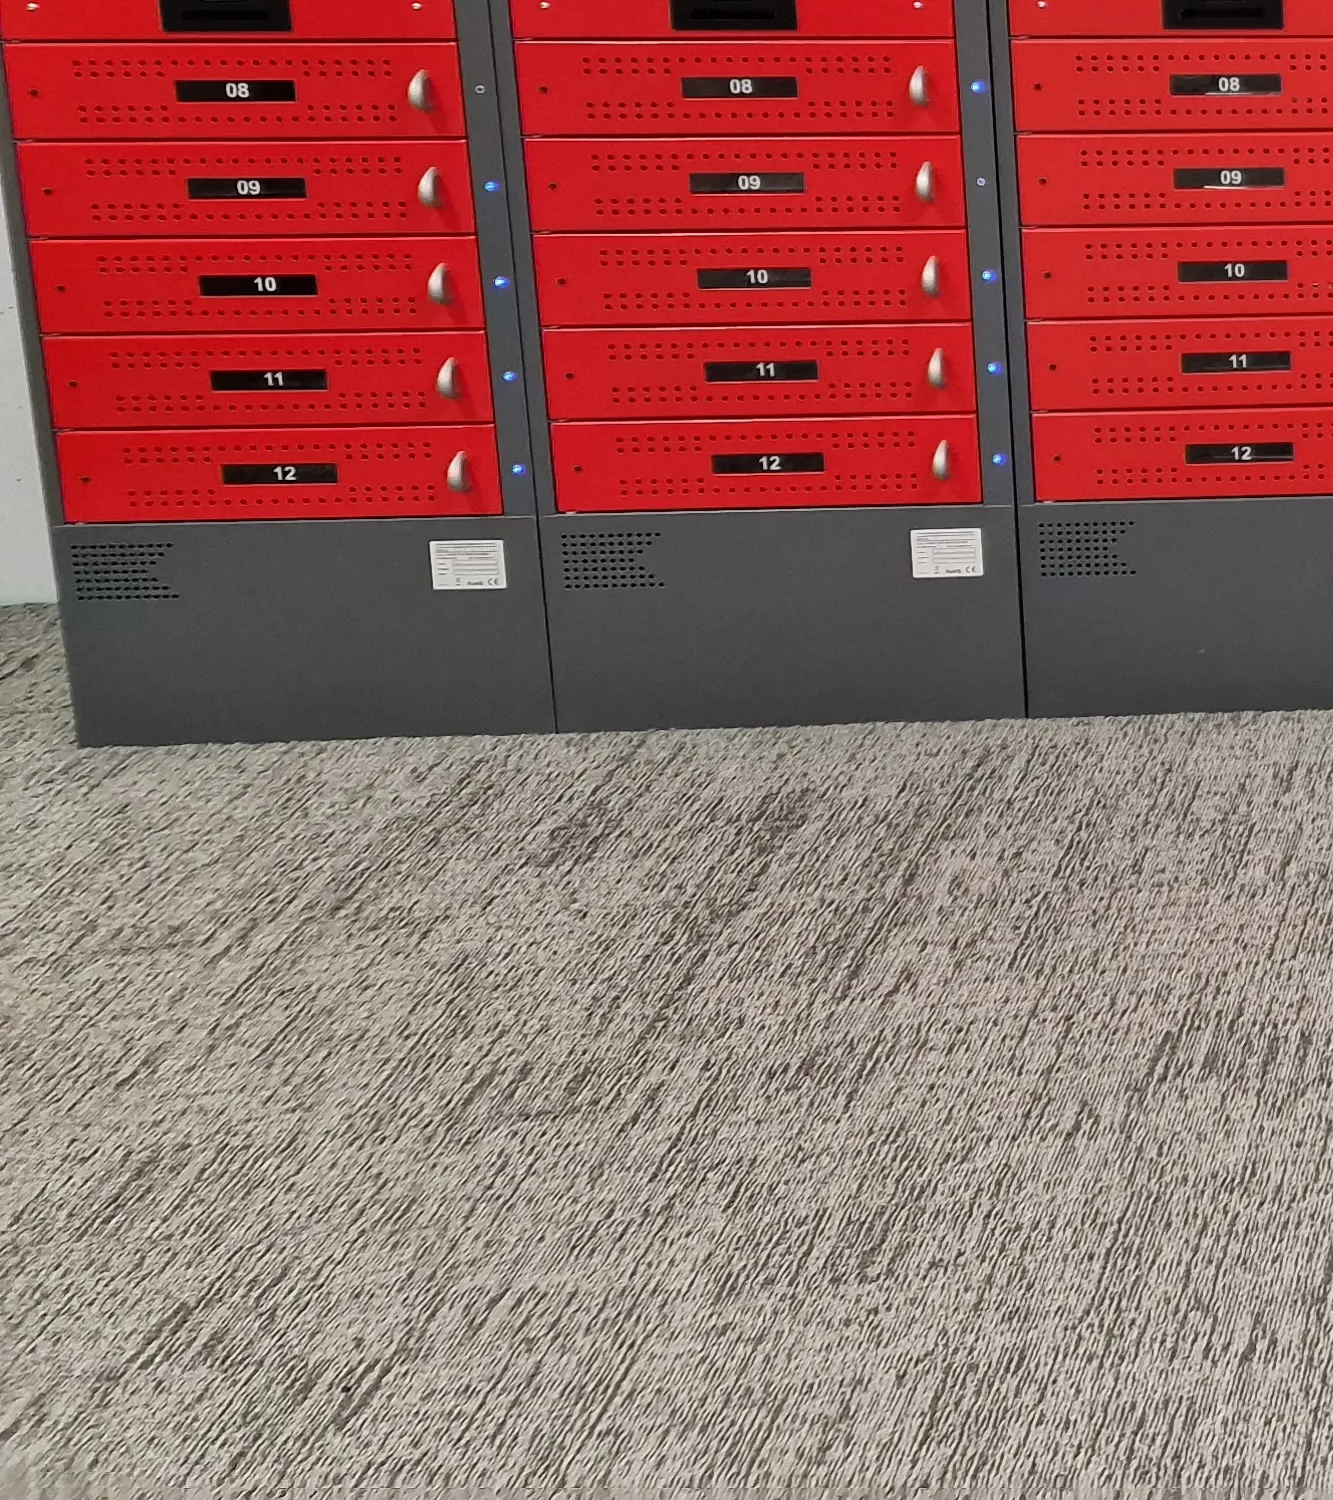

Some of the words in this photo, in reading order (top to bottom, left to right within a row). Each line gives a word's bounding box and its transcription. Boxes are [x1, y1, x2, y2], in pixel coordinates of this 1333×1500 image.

[225, 82, 250, 98] 08
[729, 78, 753, 94] 08
[1218, 76, 1241, 92] 08
[737, 175, 761, 191] 09
[1220, 170, 1242, 185] 09
[236, 180, 261, 196] 09
[746, 269, 769, 284] 10
[1224, 263, 1245, 278] 10
[253, 276, 277, 292] 10
[1228, 354, 1247, 369] 11
[755, 362, 775, 377] 11
[263, 371, 284, 386] 11
[1231, 446, 1253, 461] 12
[759, 455, 782, 471] 12
[273, 466, 297, 481] 12
